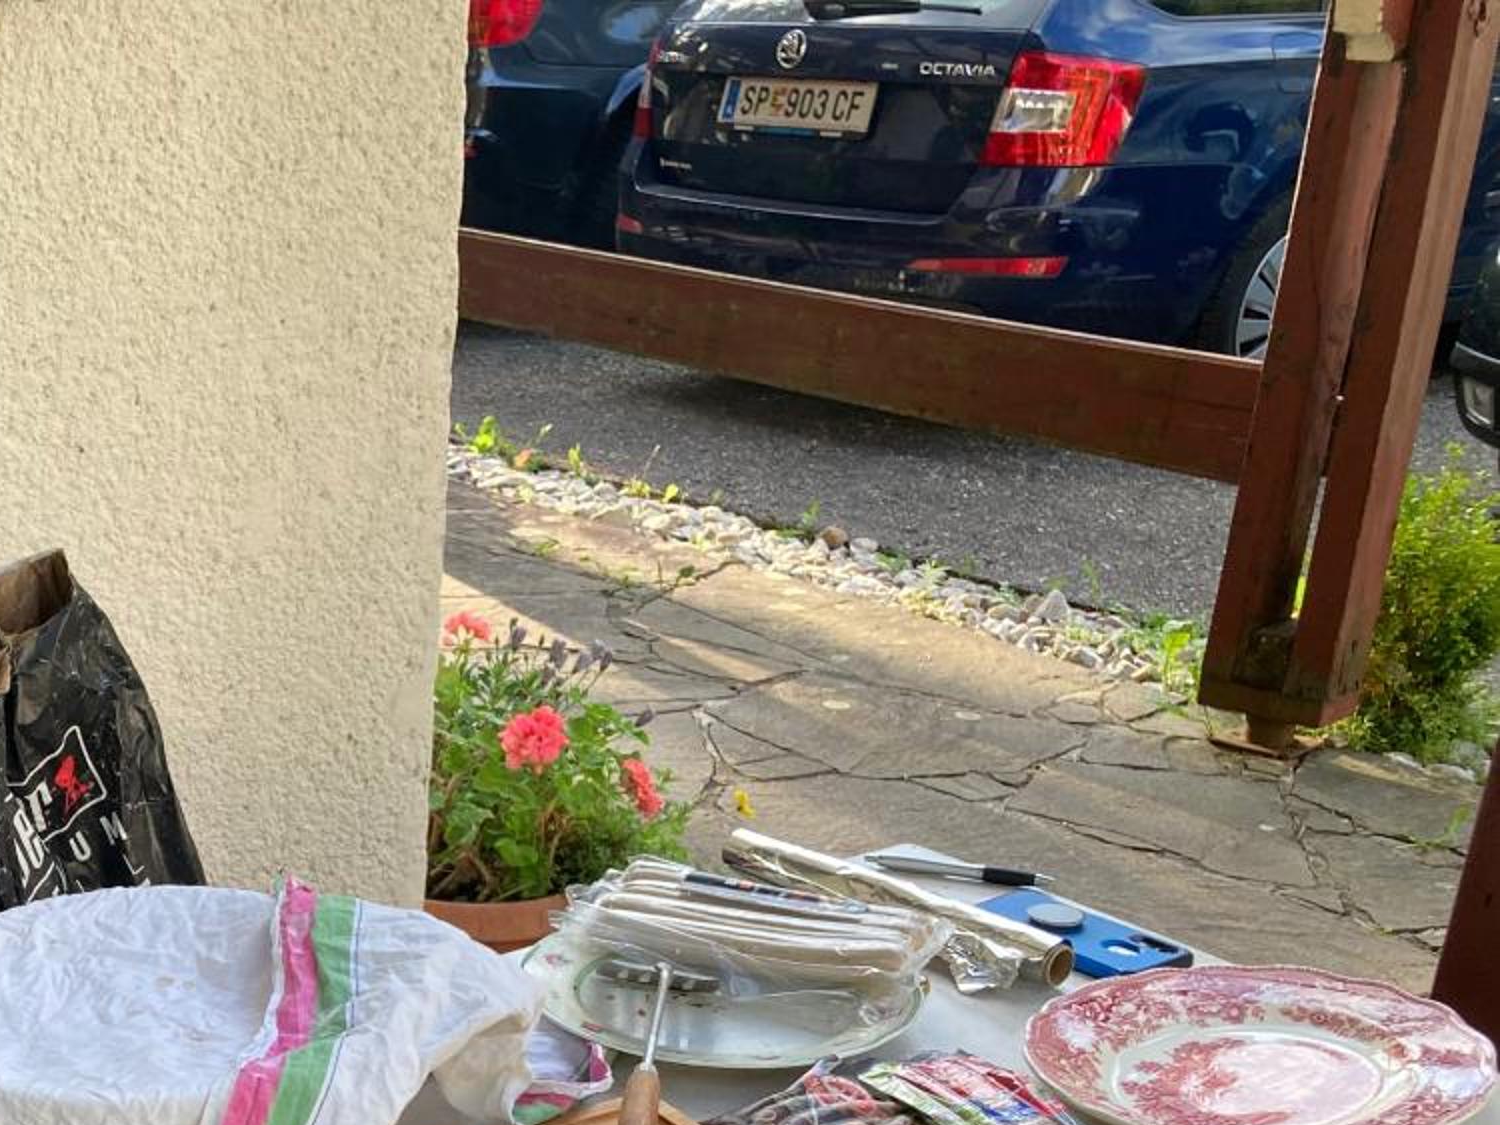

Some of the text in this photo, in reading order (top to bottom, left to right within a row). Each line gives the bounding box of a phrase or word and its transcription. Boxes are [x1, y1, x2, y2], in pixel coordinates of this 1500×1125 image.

[919, 61, 996, 77] OCTAVIA
[741, 86, 865, 122] SP 903 CF
